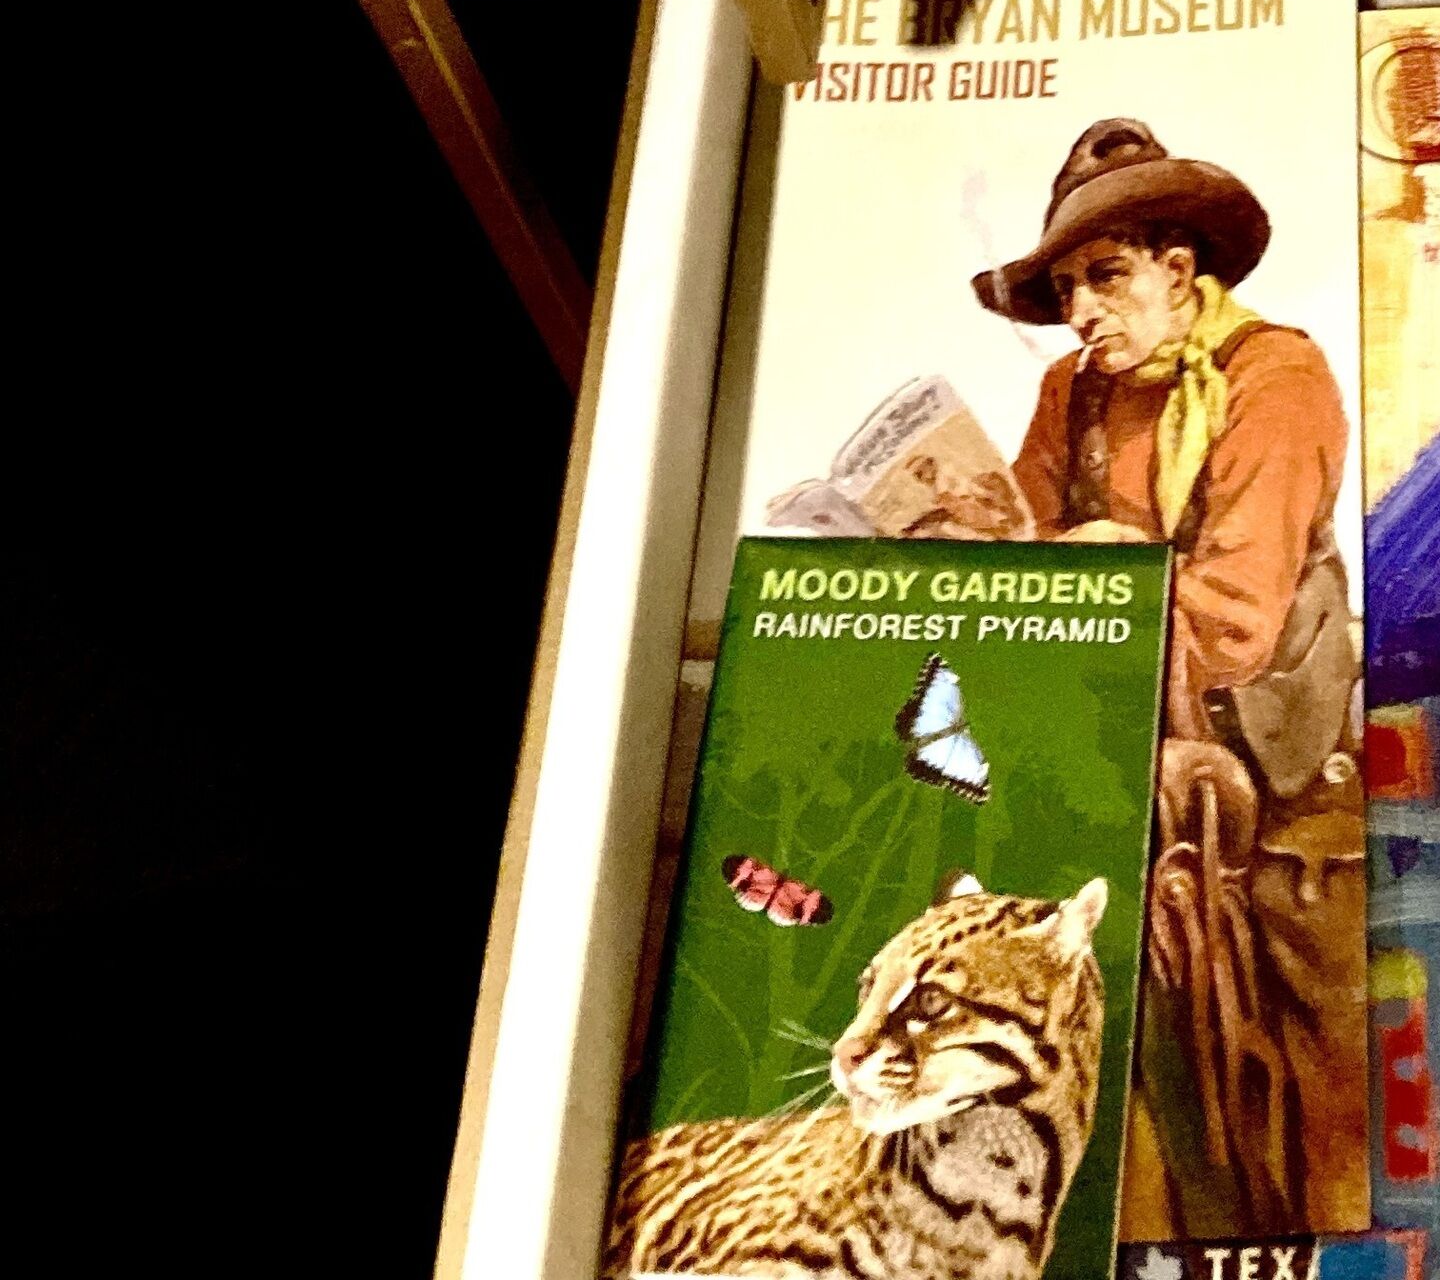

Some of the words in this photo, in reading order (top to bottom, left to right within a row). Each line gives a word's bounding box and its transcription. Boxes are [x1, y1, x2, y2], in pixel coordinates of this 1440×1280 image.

[947, 58, 1060, 101] GUIDE
[758, 567, 920, 603] MOODY
[929, 570, 1134, 606] GARDENS
[752, 611, 967, 641] RAINFOREST
[977, 614, 1132, 644] PYRAMID
